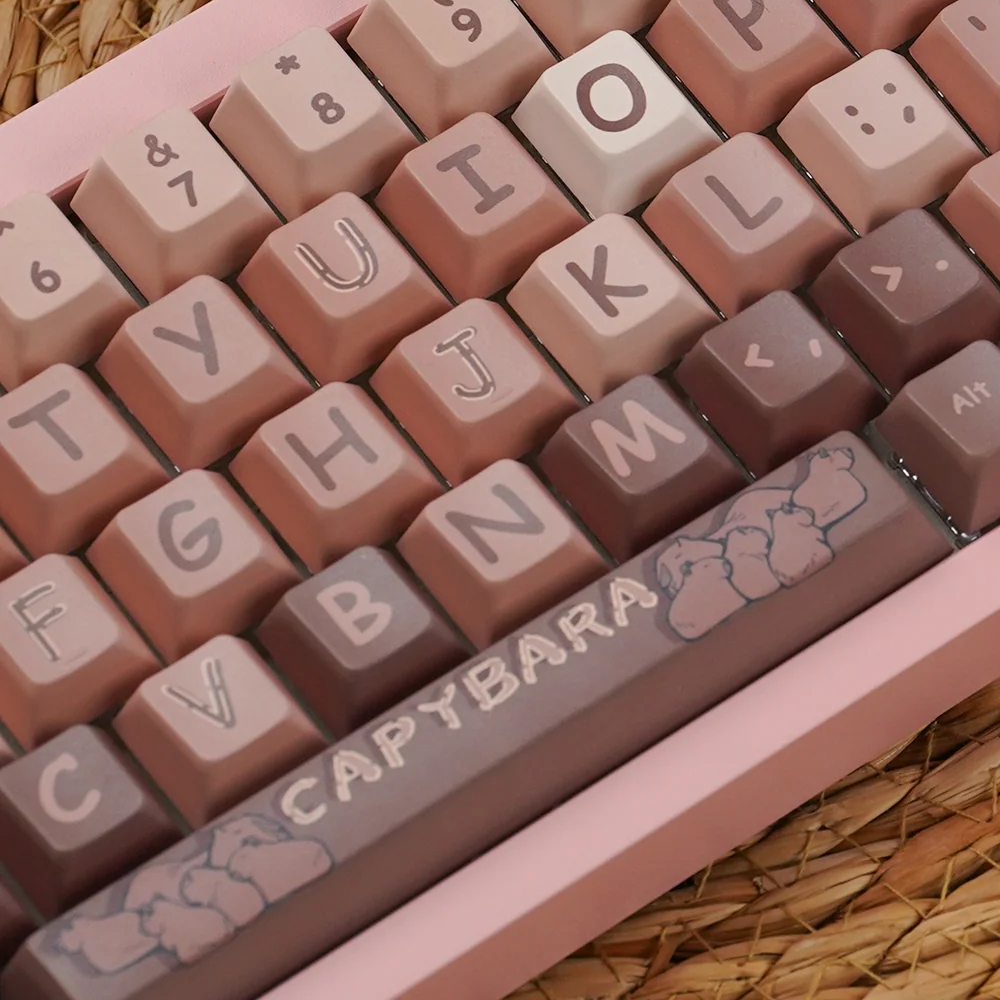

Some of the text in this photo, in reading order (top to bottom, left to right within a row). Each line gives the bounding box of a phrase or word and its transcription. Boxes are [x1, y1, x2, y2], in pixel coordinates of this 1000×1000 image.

[451, 8, 482, 42] 9
[311, 92, 345, 124] 8
[576, 63, 647, 133] O
[144, 135, 179, 167] &
[436, 144, 515, 215] I
[167, 170, 197, 207] 7
[704, 175, 784, 230] L
[30, 261, 61, 293] 6
[295, 217, 379, 293] U
[565, 244, 649, 318] K
[152, 301, 220, 376] Y
[432, 326, 498, 400] J
[8, 389, 84, 461] T
[952, 380, 992, 415] Alt
[284, 406, 379, 492] H
[590, 400, 687, 478] M
[157, 499, 223, 573] G
[445, 483, 545, 565] N
[8, 580, 65, 662] F
[316, 580, 393, 647] B
[161, 656, 236, 729] V
[280, 576, 659, 825] CAPYBARA
[38, 753, 101, 823] C
